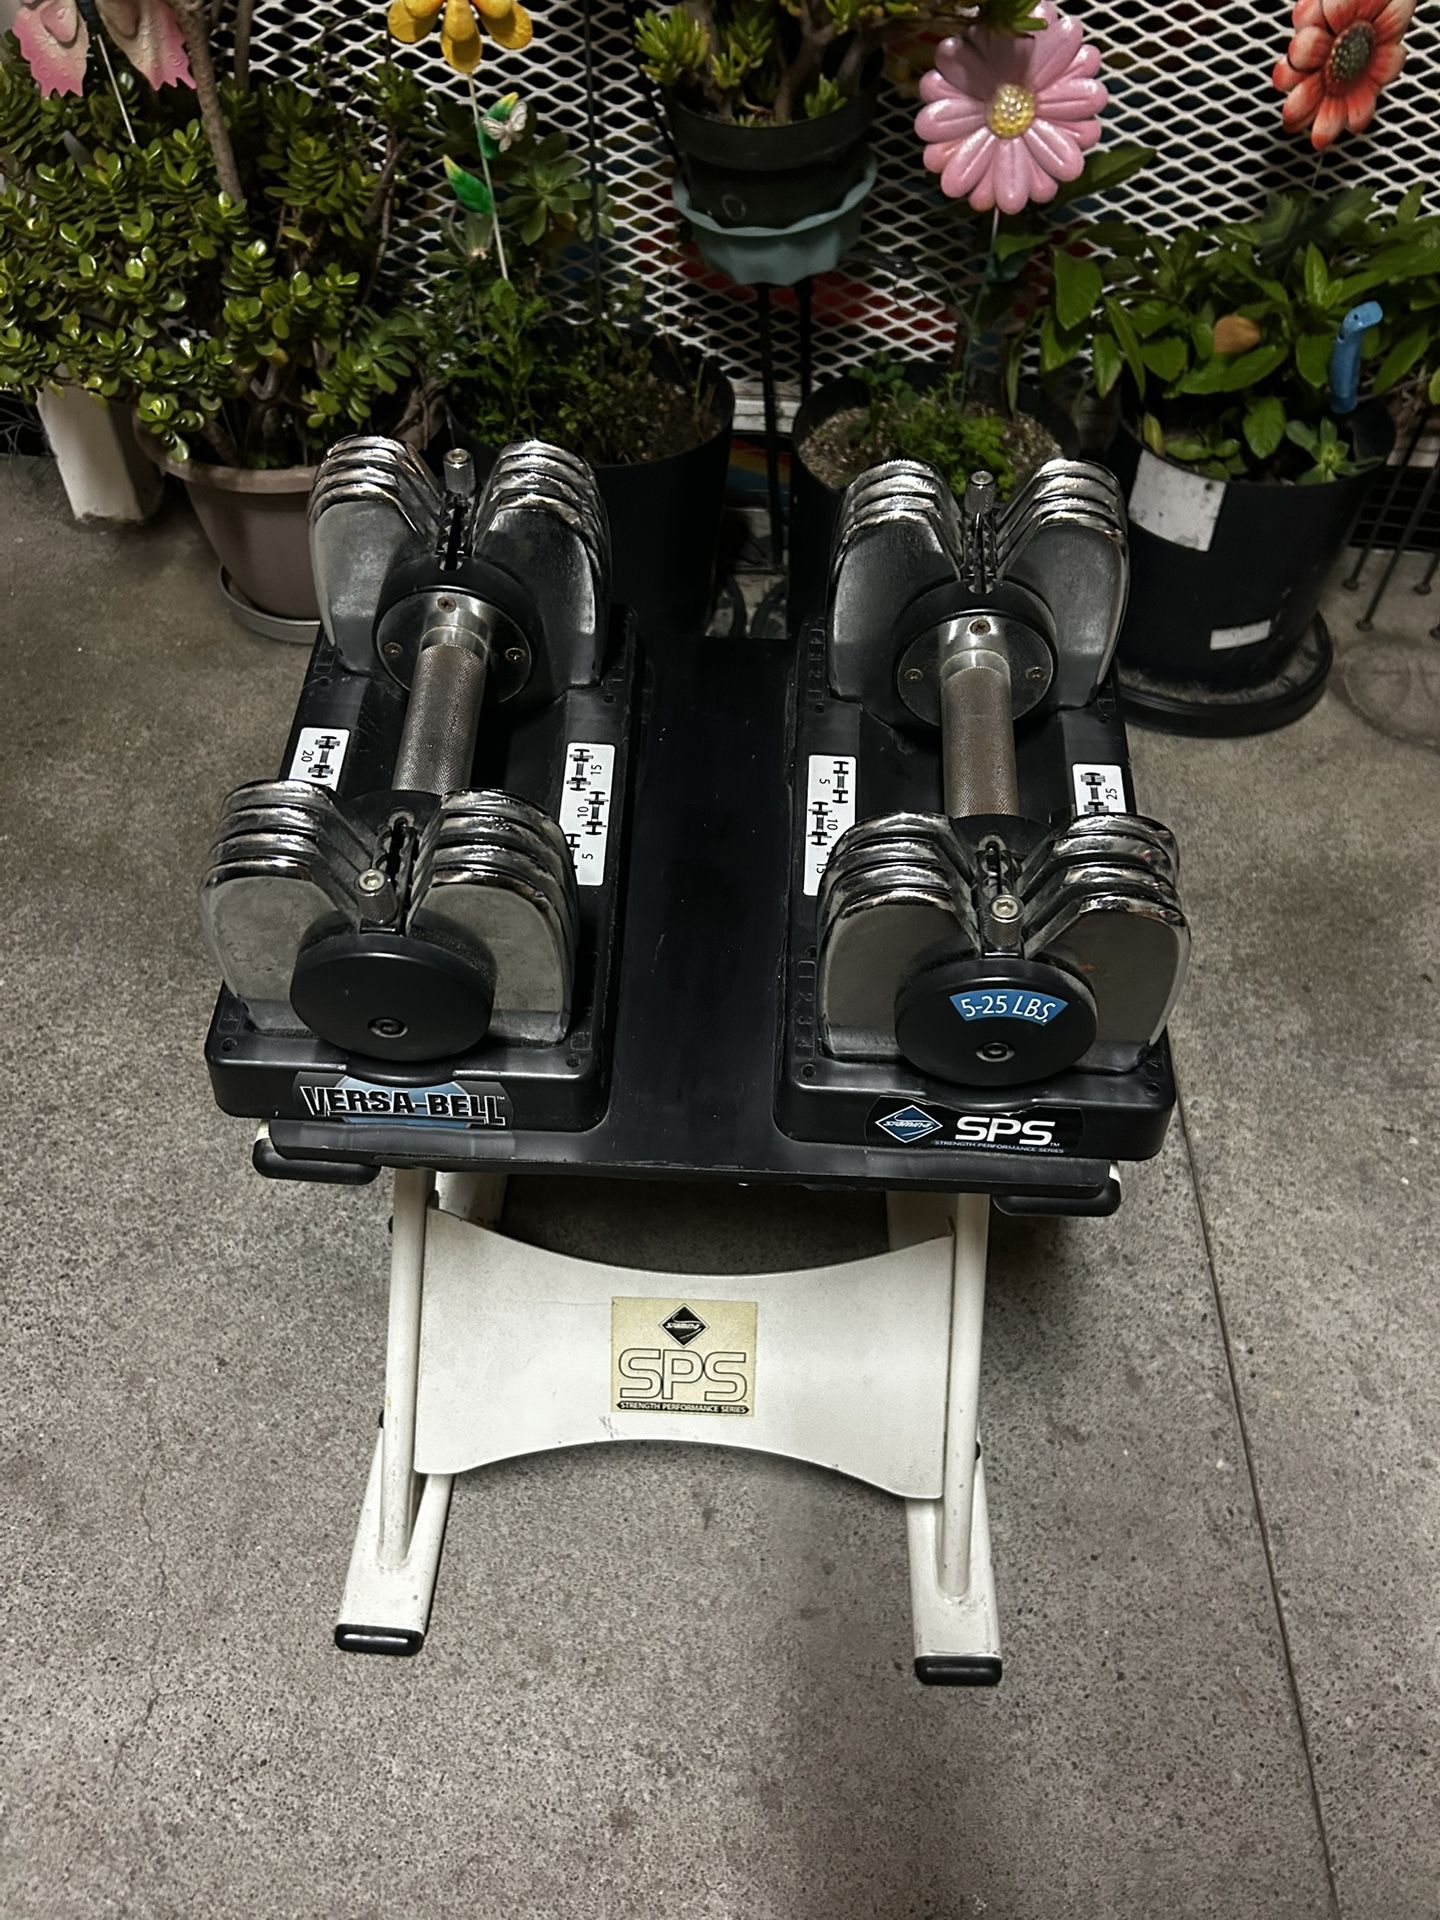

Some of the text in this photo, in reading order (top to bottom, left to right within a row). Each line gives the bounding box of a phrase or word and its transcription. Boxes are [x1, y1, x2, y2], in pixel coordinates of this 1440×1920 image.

[301, 750, 315, 762] 20
[590, 764, 602, 775] 15
[1105, 788, 1118, 801] 25
[577, 806, 589, 818] 10
[827, 819, 839, 831] 10
[960, 995, 1056, 1023] 5-25 LBS.
[300, 1086, 506, 1126] VERSA-BELL
[955, 1116, 1056, 1146] SPS
[977, 1142, 1036, 1152] PERFORMANCE
[618, 1347, 748, 1403] SPS
[619, 1401, 746, 1414] STRENGTH PERFORMANCE SERIES
